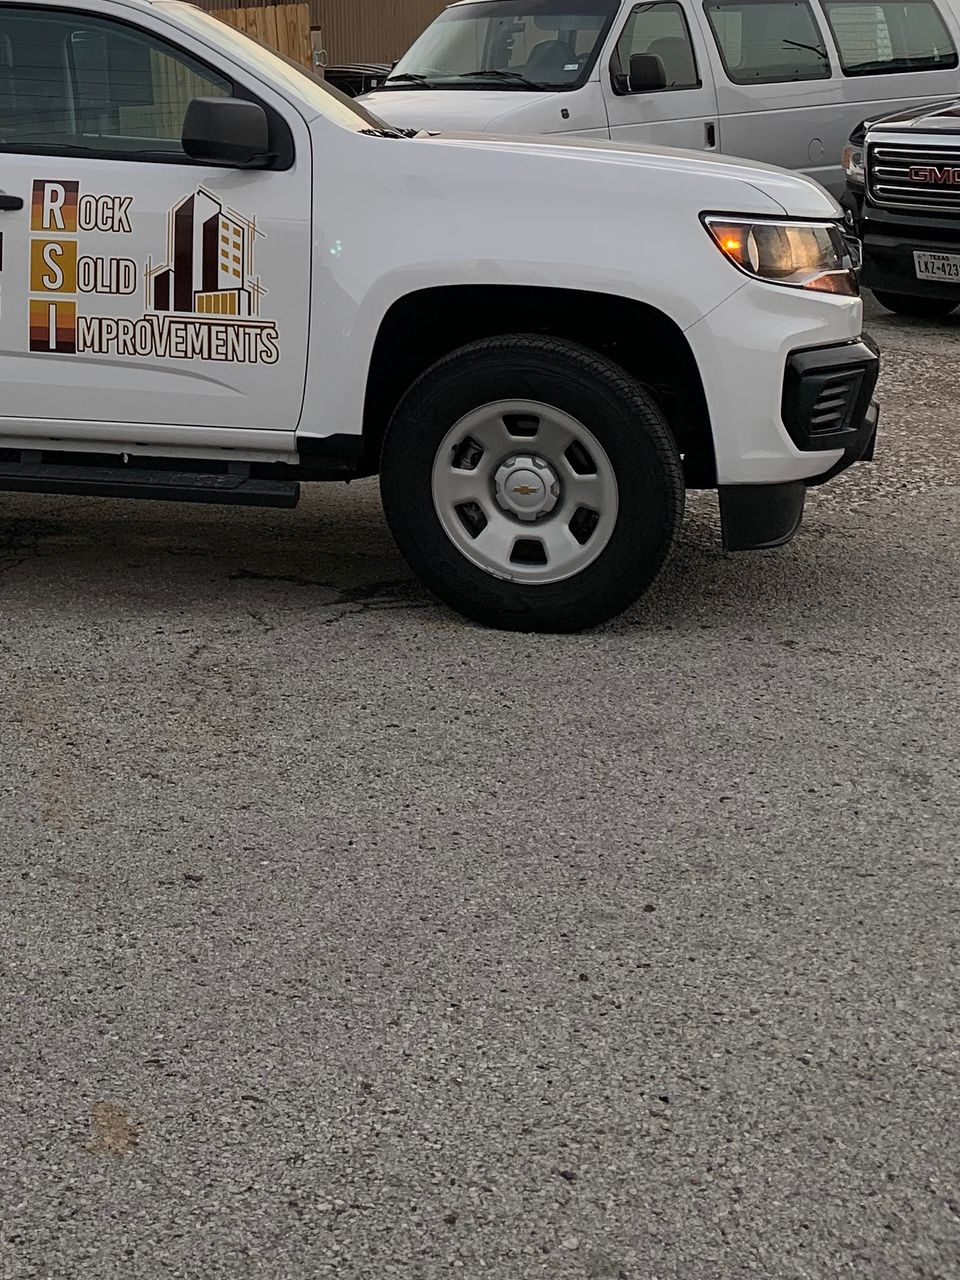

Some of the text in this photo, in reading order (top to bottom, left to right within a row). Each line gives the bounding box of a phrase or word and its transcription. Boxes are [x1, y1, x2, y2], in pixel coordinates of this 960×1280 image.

[42, 182, 133, 232] ROCK
[41, 242, 136, 295] SOLID
[918, 260, 960, 277] LKZ-423
[47, 303, 279, 364] IMPROVEMENTS
